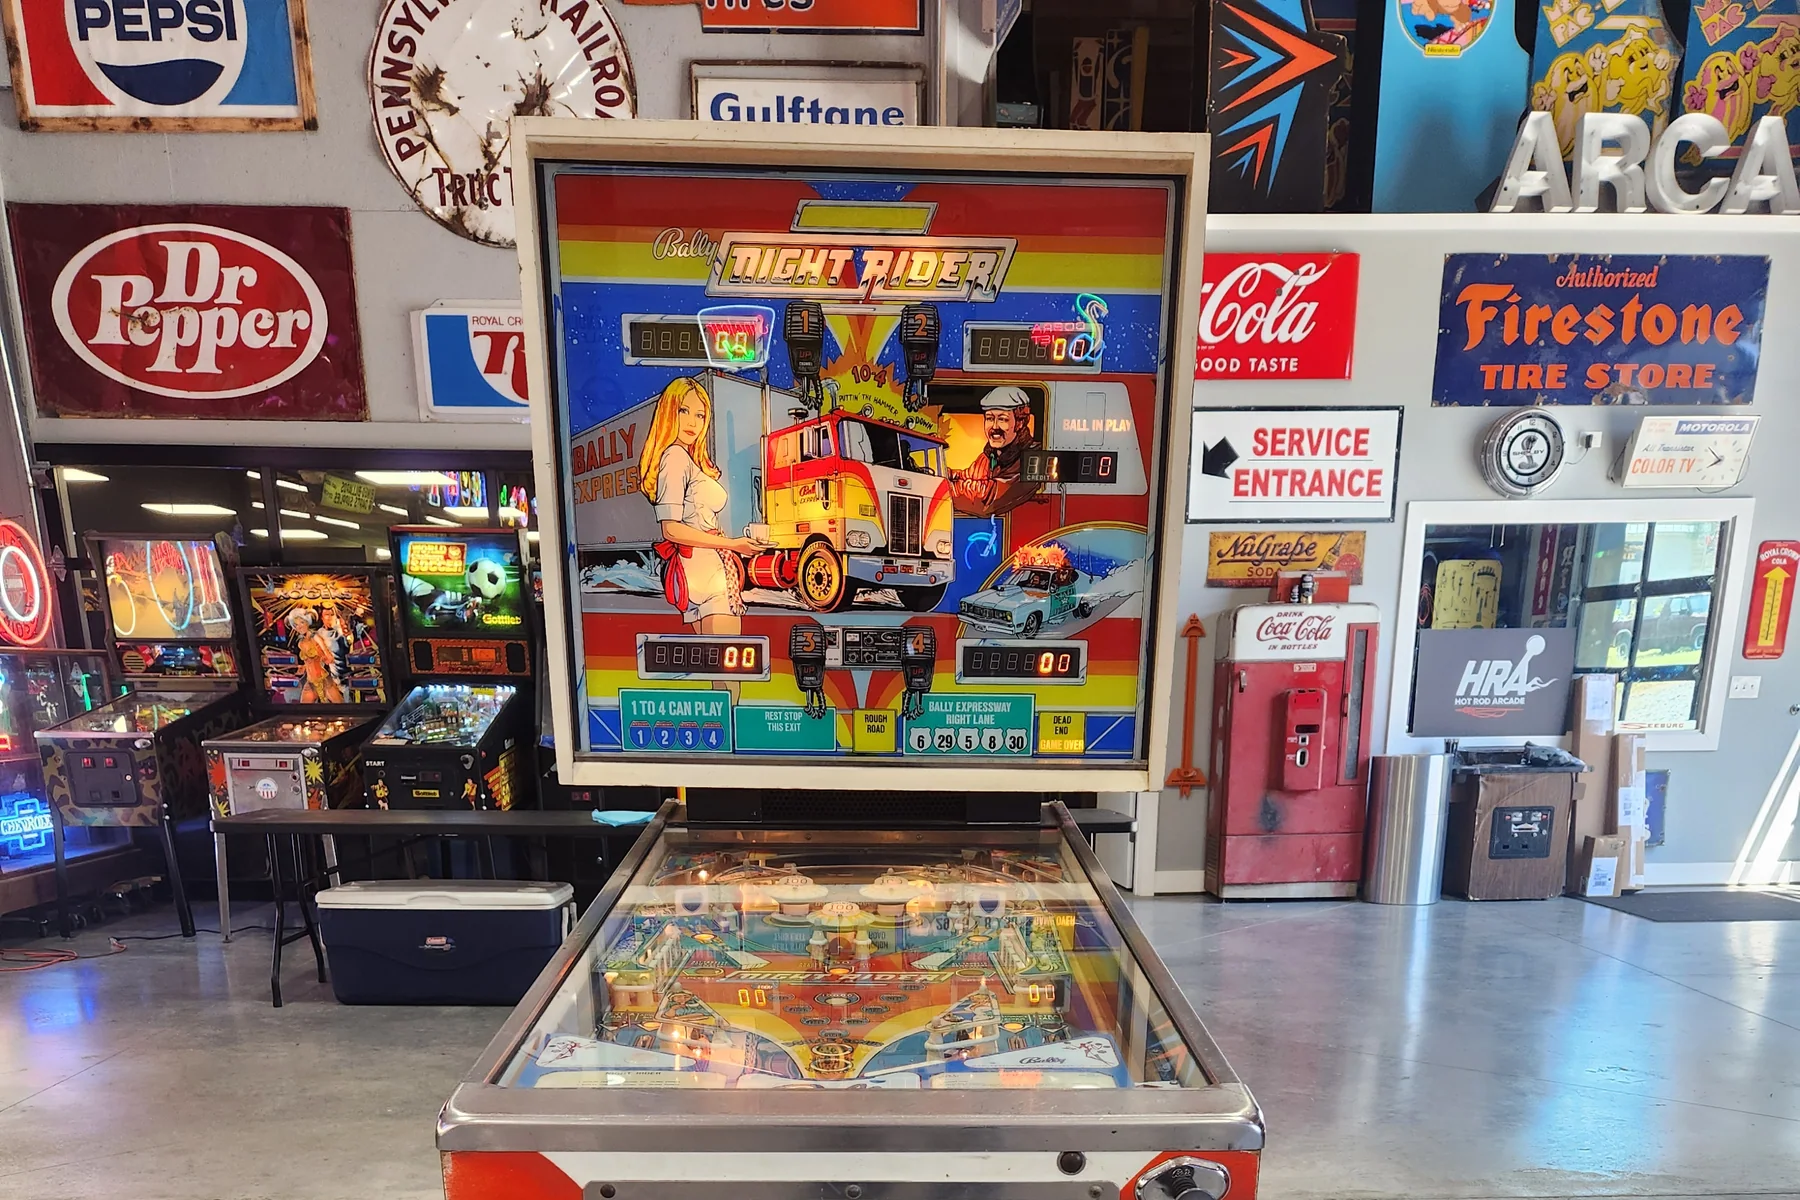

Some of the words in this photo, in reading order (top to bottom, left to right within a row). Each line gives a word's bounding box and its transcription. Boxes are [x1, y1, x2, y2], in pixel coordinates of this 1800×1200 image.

[75, 0, 238, 42] PEPSI
[380, 0, 450, 162] PENNSYL
[550, 0, 626, 119] AILRO
[710, 92, 905, 126] Gulftane
[1492, 111, 1800, 214] ARCA
[652, 227, 719, 266] Bally
[155, 239, 258, 305] Dr
[730, 247, 854, 285] NIGHT
[859, 249, 1000, 297] RIDER
[1556, 264, 1660, 289] Authorized
[87, 273, 311, 374] Pepper
[472, 316, 504, 326] ROYAL
[507, 316, 523, 326] CR
[800, 309, 810, 334] 1
[914, 313, 928, 336] 2
[1456, 283, 1745, 351] Firestone
[1195, 357, 1240, 372] OOD
[1249, 357, 1299, 372] TASTE
[851, 364, 888, 389] 10-4
[1480, 364, 1568, 390] TIRE
[1584, 363, 1716, 389] STORE
[873, 396, 899, 416] HAMMER
[915, 415, 934, 431] DOWN
[1063, 418, 1089, 431] BALL
[1092, 419, 1103, 431] IN
[1105, 419, 1132, 432] PLAY
[1680, 423, 1750, 432] MOTOROLA
[573, 423, 636, 476] BALLY
[1253, 428, 1370, 457] SERVICE
[1631, 458, 1677, 474] COLOR
[1679, 458, 1697, 473] TV
[574, 465, 641, 504] XPRES
[1233, 468, 1383, 498] ENTRANCE
[411, 543, 447, 555] WORLD
[1217, 533, 1317, 566] NuGrape
[1760, 547, 1779, 561] ROYAL
[410, 559, 463, 573] SOCCER
[293, 581, 338, 590] BUCK
[277, 589, 352, 599] ROGERS
[482, 613, 522, 625] Gottlieb
[802, 632, 815, 652] 3
[912, 632, 925, 653] 4
[803, 666, 815, 674] UP
[1456, 659, 1529, 696] HRA
[631, 701, 637, 715] 1
[639, 701, 655, 715] TO
[658, 701, 666, 715] 4
[669, 701, 692, 716] CAN
[695, 702, 723, 716] PLAY
[929, 701, 954, 712] BALLY
[956, 702, 1012, 712] EXPRESSWAY
[1491, 697, 1526, 705] ARCADE
[765, 711, 782, 720] REST
[783, 711, 803, 720] STOP
[864, 714, 888, 723] ROUGH
[946, 714, 971, 724] RIGHT
[973, 714, 995, 724] LANE
[1053, 716, 1072, 724] DEAD
[767, 722, 783, 731] THIS
[785, 722, 801, 732] EXIT
[867, 724, 885, 733] ROAD
[1055, 727, 1069, 735] END
[637, 730, 644, 744] 1
[662, 730, 669, 744] 2
[685, 730, 692, 744] 3
[709, 731, 717, 745] 4
[917, 735, 925, 748] 6
[937, 735, 951, 748] 29
[964, 735, 972, 748] 5
[988, 735, 996, 749] 8
[1009, 736, 1024, 749] 30
[1040, 740, 1063, 750] GAME
[1064, 740, 1084, 750] OVER
[736, 973, 832, 981] NIGHT
[835, 973, 940, 983] RIDER
[1019, 1056, 1067, 1065] Bally
